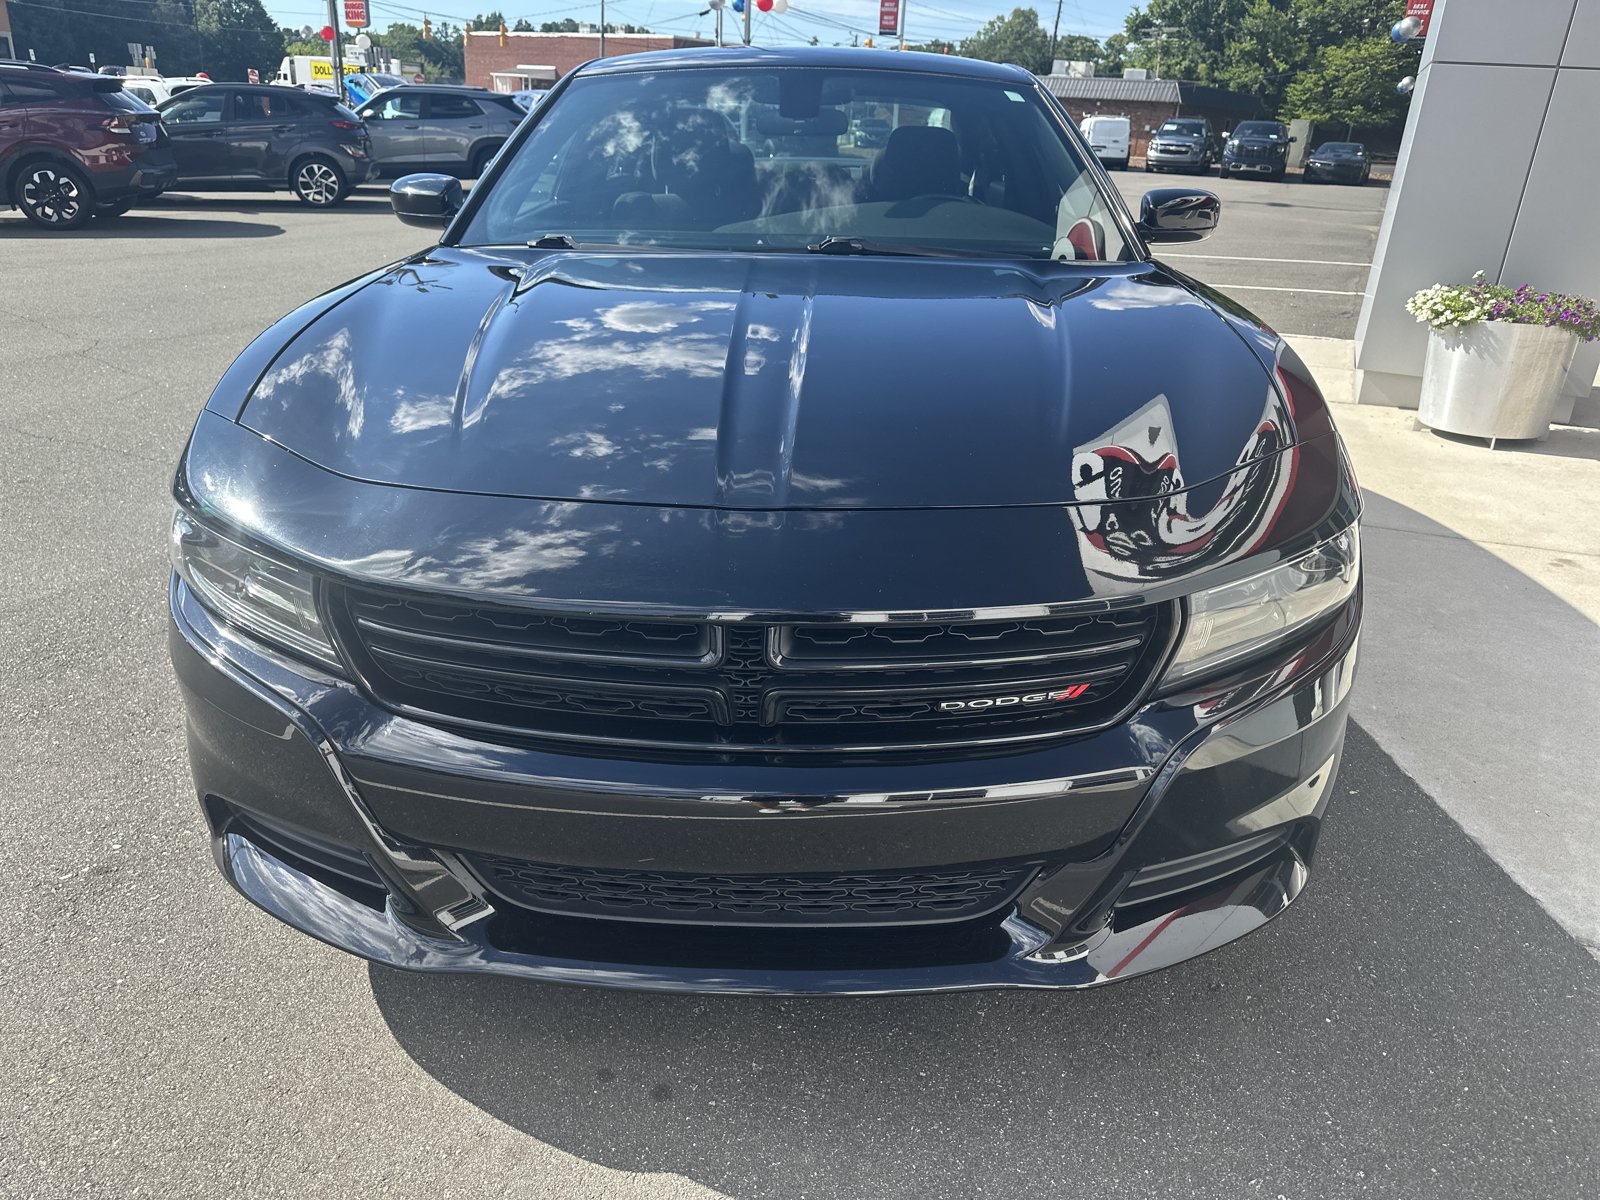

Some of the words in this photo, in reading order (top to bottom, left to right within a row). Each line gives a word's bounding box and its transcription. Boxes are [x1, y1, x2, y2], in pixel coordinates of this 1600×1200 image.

[344, 2, 365, 10] BURGER
[345, 10, 366, 20] KING
[314, 65, 334, 76] DOLL
[940, 690, 1071, 710] DODGE
